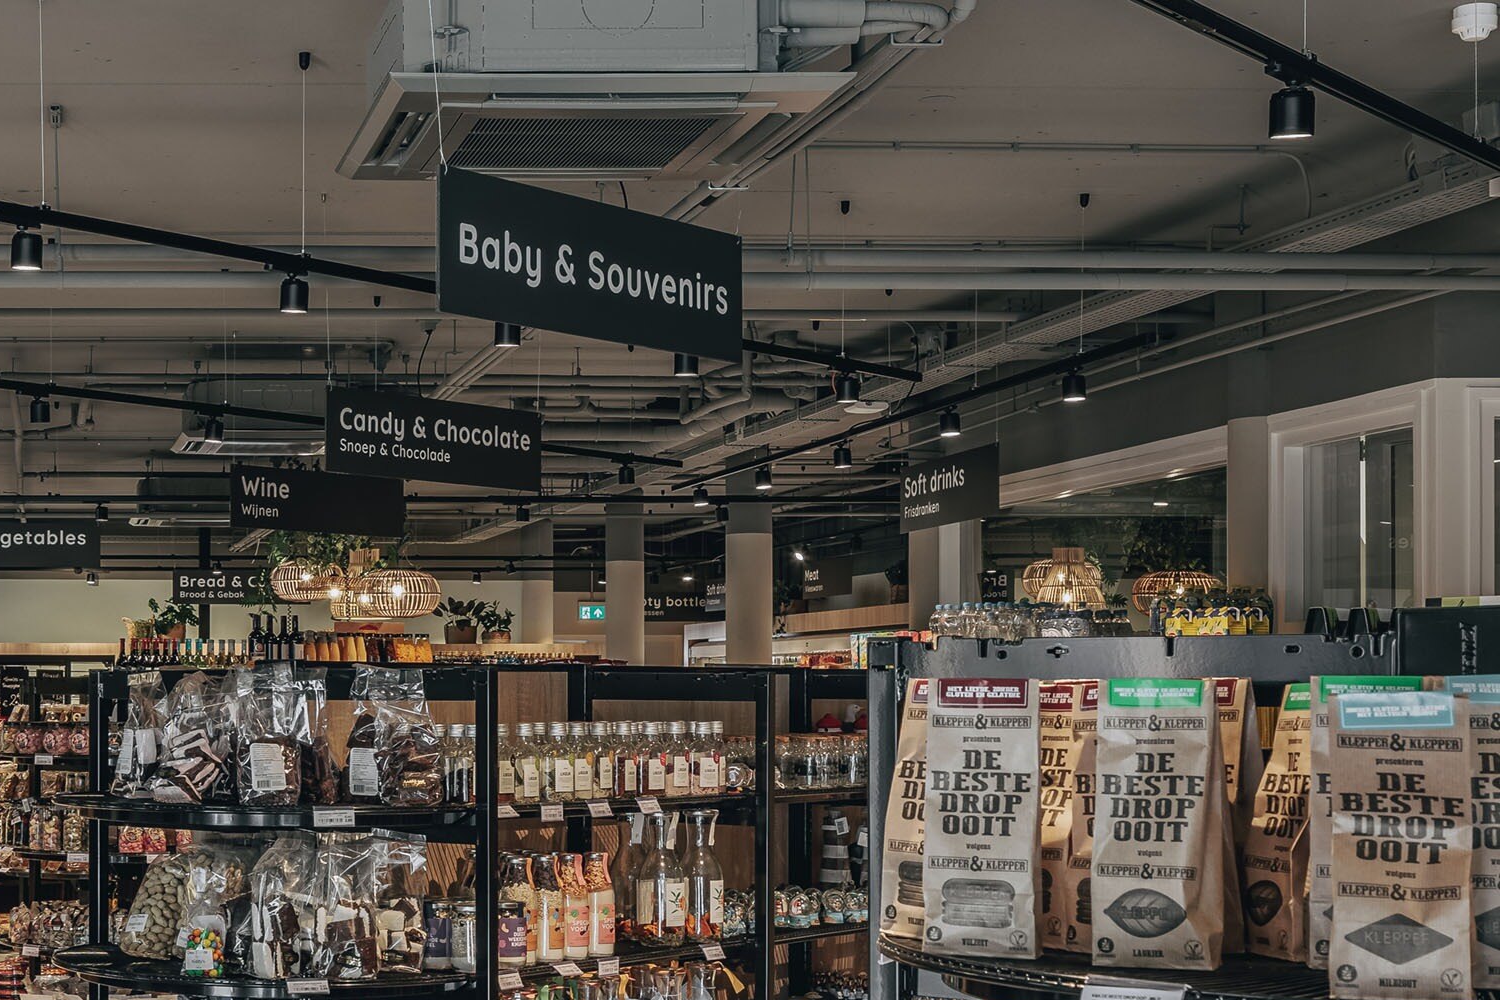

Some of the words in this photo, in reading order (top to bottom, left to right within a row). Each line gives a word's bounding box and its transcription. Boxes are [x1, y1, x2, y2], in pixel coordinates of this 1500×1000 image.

[458, 222, 541, 288] Baby
[555, 244, 576, 286] &
[588, 250, 729, 316] Souvenirs
[339, 407, 405, 442] Candy
[412, 415, 427, 439] &
[434, 418, 531, 452] Chocolate
[339, 437, 376, 458] Snoep
[379, 442, 388, 457] &
[391, 443, 451, 463] Chocolade
[241, 475, 290, 499] Wine
[904, 472, 927, 499] Soft
[930, 464, 965, 494] drinks
[241, 503, 279, 519] Wijnen
[904, 501, 940, 520] Frisdranken
[180, 575, 226, 588] Bread
[231, 576, 243, 588] &
[804, 569, 819, 582] Meat
[179, 591, 203, 599] Brood
[208, 591, 215, 599] &
[216, 591, 245, 599] Gebak
[935, 716, 974, 728] KLEPPER
[974, 713, 988, 730] &
[990, 716, 1030, 728] KLEPPER
[1106, 717, 1147, 729] KLEPPER
[1148, 714, 1162, 731] &
[1164, 718, 1206, 730] KLEPPER
[962, 735, 1001, 744] presenteren
[1135, 738, 1176, 746] presenteren
[1340, 735, 1389, 748] KLEPPER
[1389, 733, 1406, 752] &
[1409, 736, 1462, 751] KLEPPER
[962, 750, 1002, 770] DE
[1135, 752, 1175, 774] DE
[1375, 757, 1424, 767] presenteren
[931, 770, 1032, 793] BESTE
[1101, 774, 1205, 797] BESTE
[1376, 772, 1426, 794] DE
[938, 793, 1023, 815] DROP
[1109, 797, 1196, 820] DROP
[1339, 792, 1465, 817] BESTE
[942, 816, 1016, 837] OOIT
[1113, 820, 1190, 843] OOIT
[1351, 814, 1456, 841] DROP
[888, 840, 917, 853] KLEPPER
[966, 842, 992, 851] volgens
[1137, 849, 1163, 858] volgens
[1356, 839, 1448, 865] OOIT
[930, 858, 970, 870] KLEPPER
[970, 855, 984, 873] &
[985, 859, 1027, 872] KLEPPER
[1099, 865, 1141, 878] KLEPPER
[1140, 863, 1155, 880] &
[1157, 867, 1196, 880] KLEPPER
[1384, 869, 1417, 879] volgens
[1342, 884, 1390, 898] KLEPPER
[1390, 883, 1408, 901] &
[1410, 886, 1460, 900] KLEPPER
[1132, 949, 1164, 959] LAURIER
